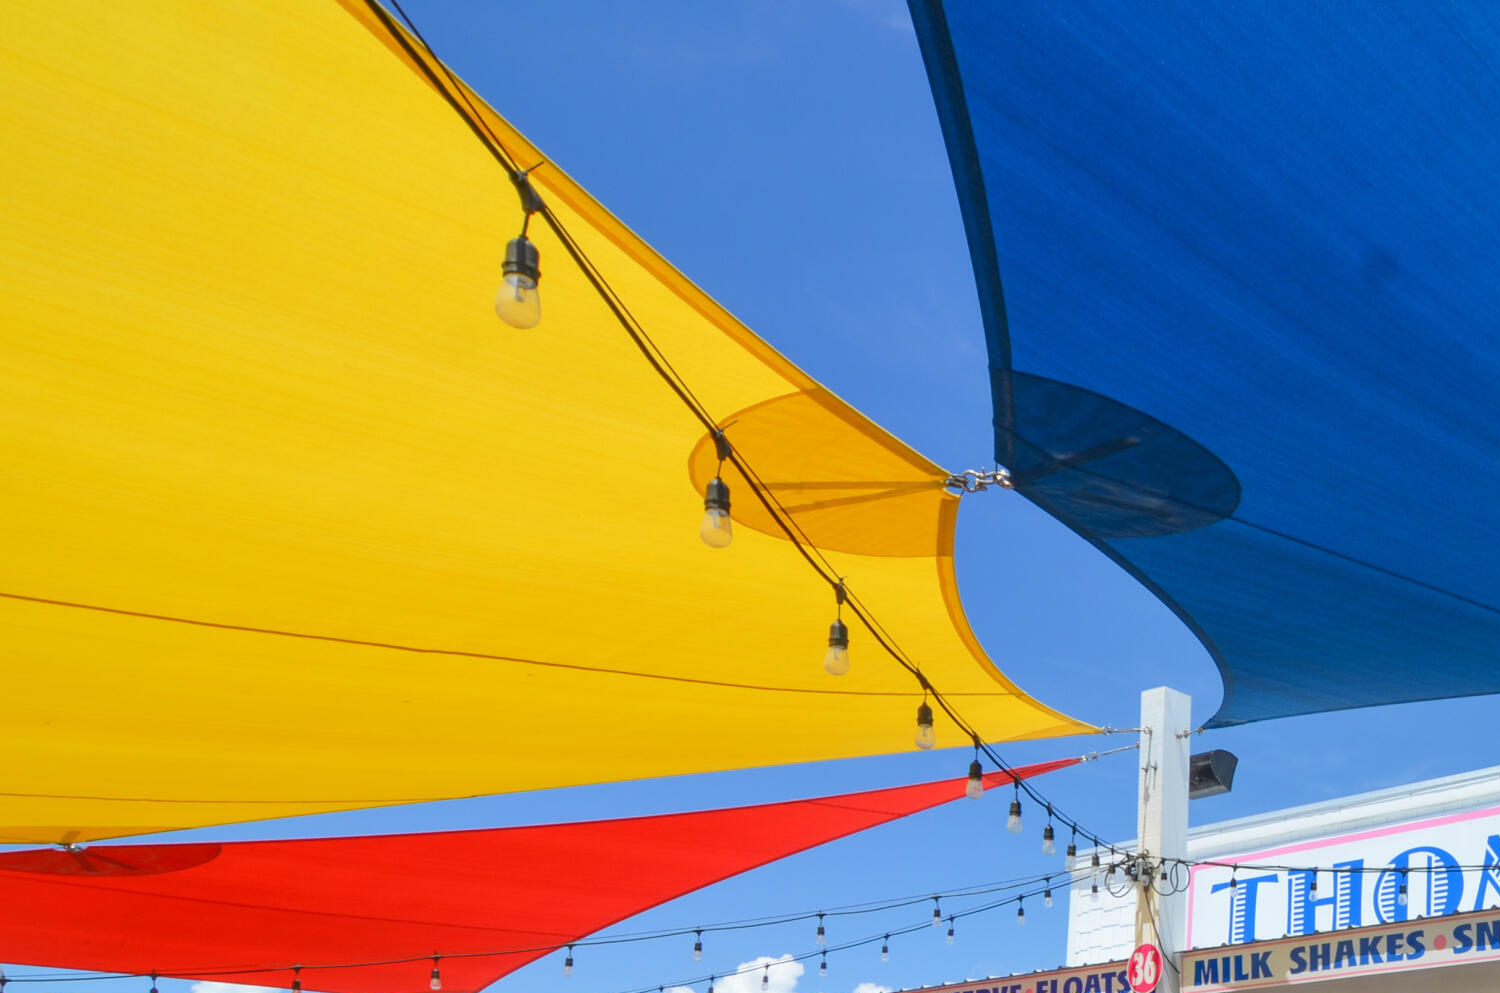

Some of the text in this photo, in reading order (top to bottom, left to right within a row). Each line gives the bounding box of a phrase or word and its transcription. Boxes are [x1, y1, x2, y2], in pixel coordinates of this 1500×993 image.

[1132, 950, 1155, 986] 36
[1193, 949, 1273, 988] MILK
[1289, 929, 1426, 975] SHAKES
